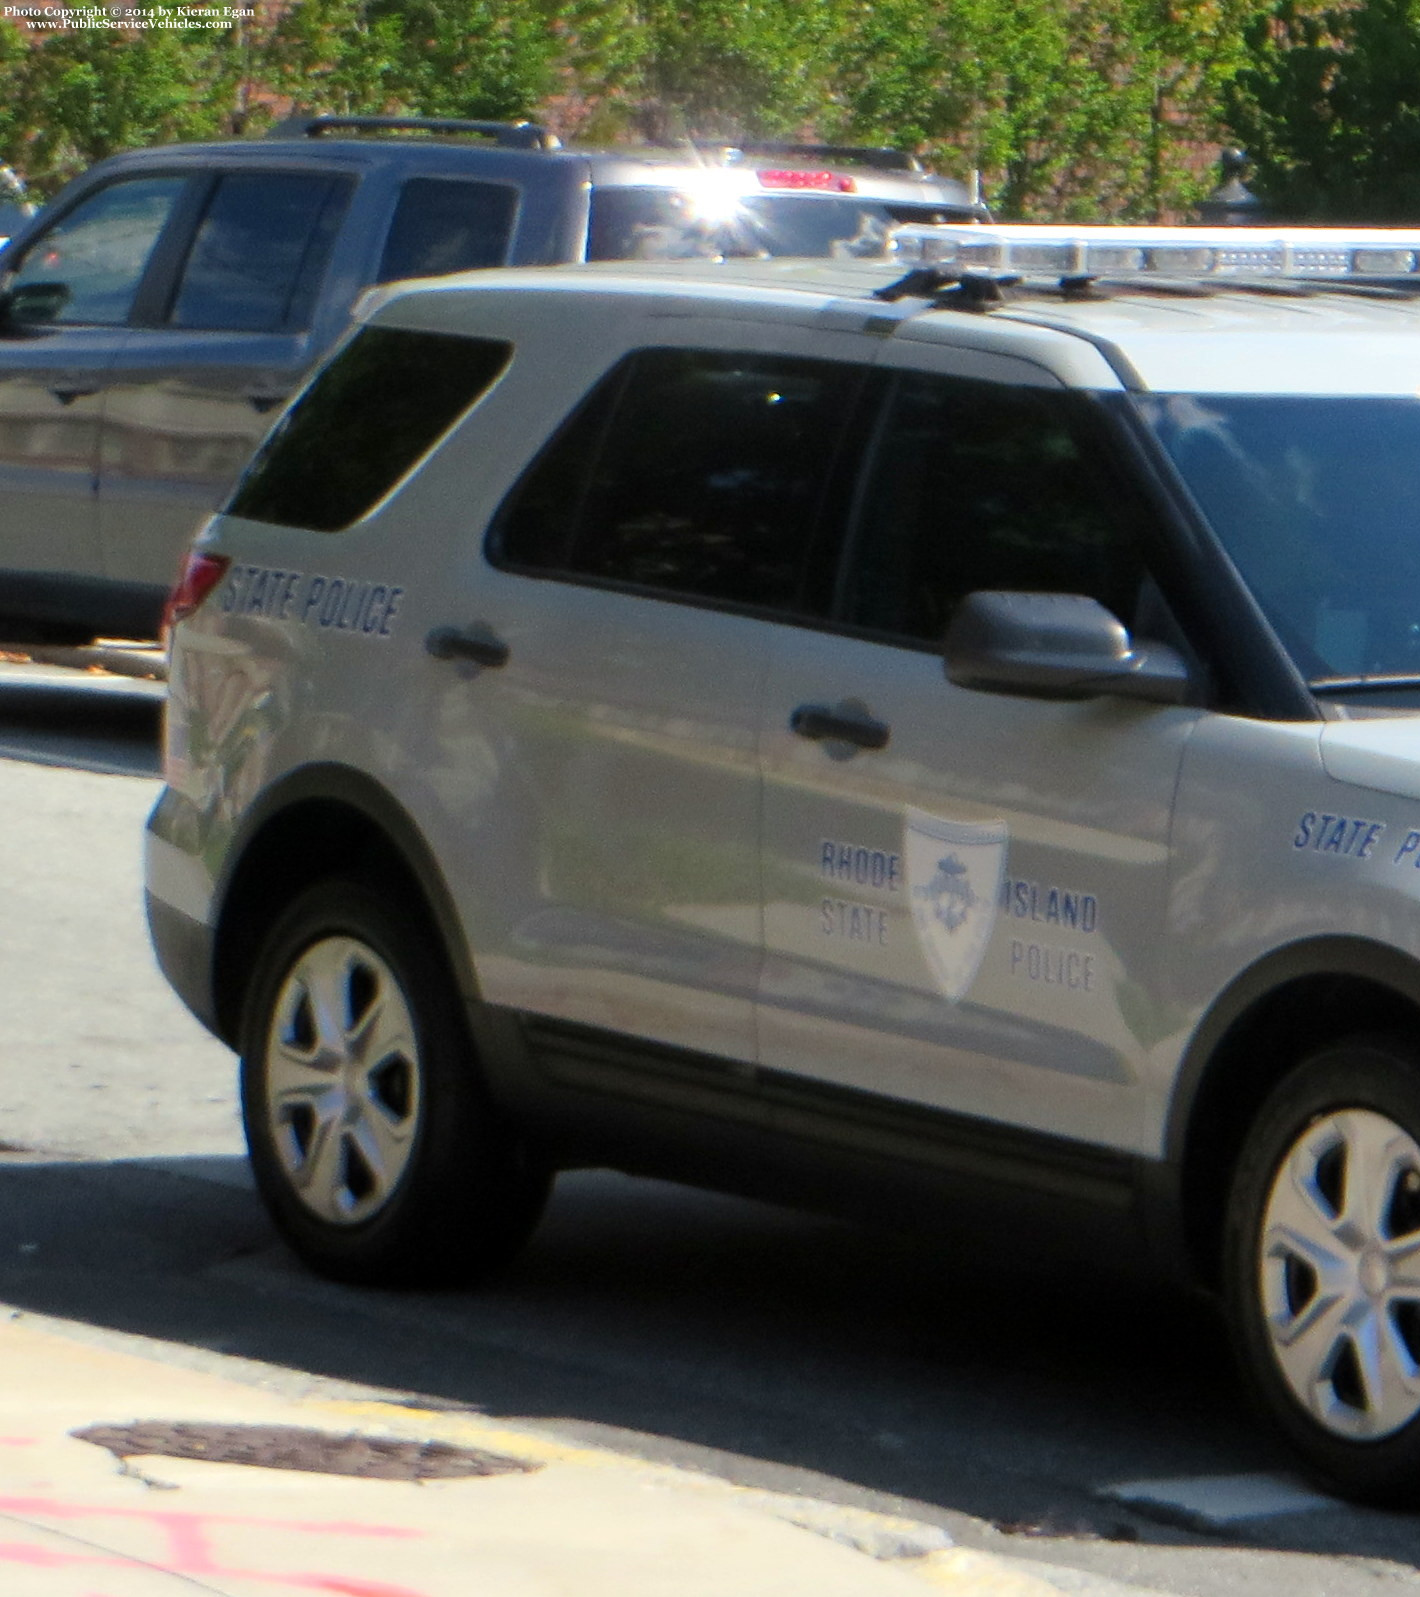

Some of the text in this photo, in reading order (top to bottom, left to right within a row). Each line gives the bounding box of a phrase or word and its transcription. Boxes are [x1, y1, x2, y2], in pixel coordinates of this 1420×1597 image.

[222, 564, 404, 636] STATE POLICE
[1294, 811, 1386, 859] STATE
[821, 841, 1097, 933] RHODE ISLAND
[821, 898, 1094, 992] STATE POLICE
